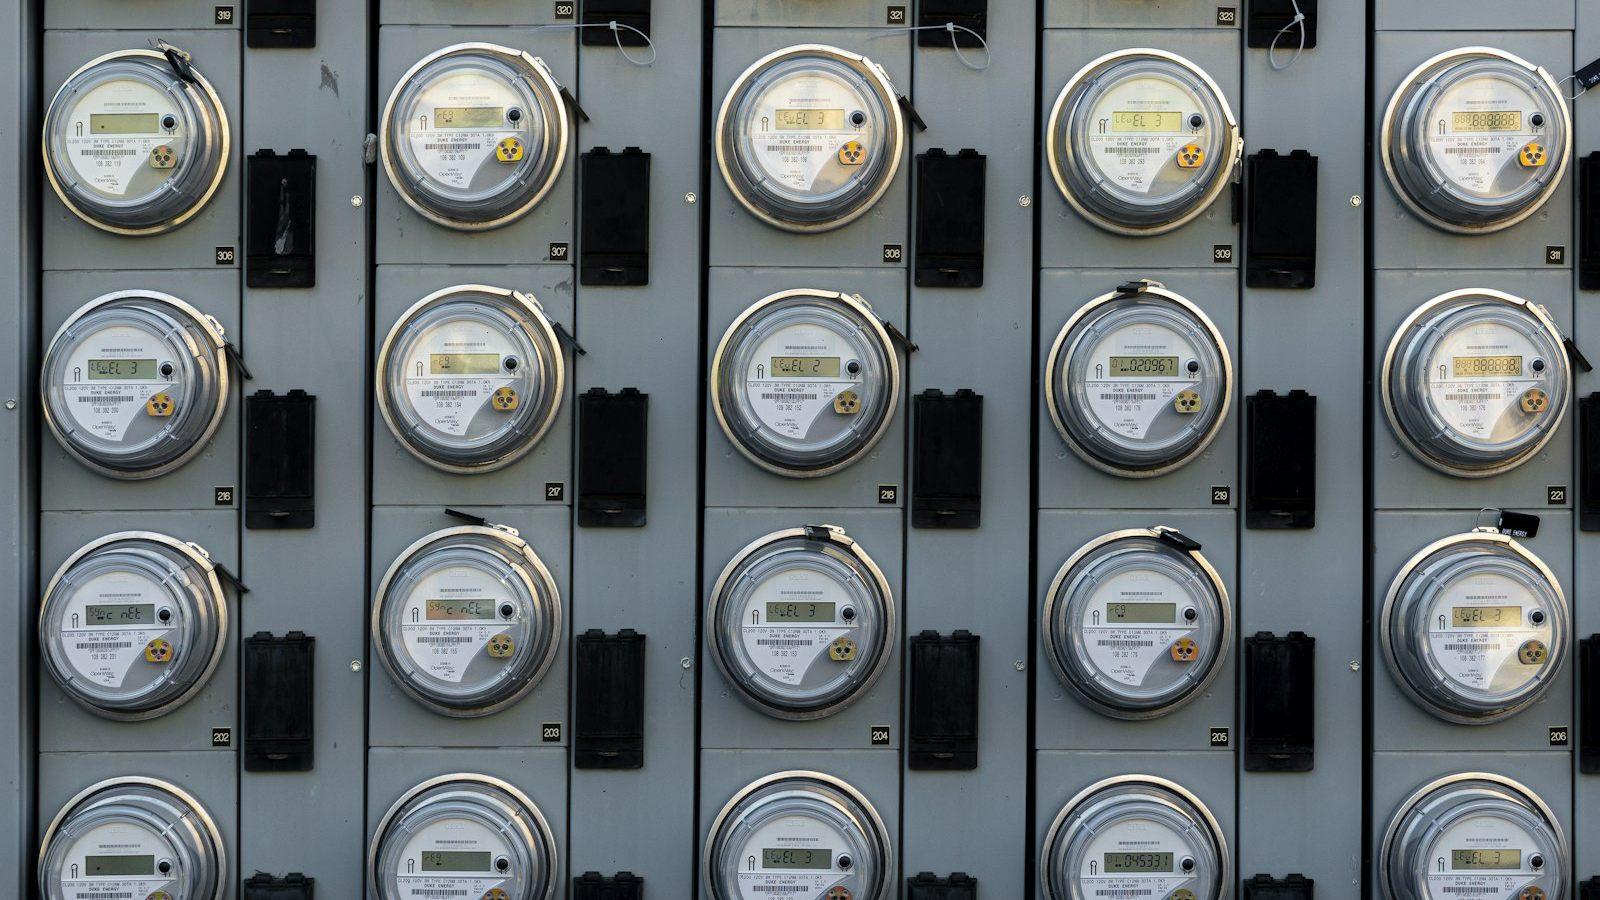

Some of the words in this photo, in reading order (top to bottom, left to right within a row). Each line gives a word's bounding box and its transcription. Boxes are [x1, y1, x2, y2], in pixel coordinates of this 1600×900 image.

[217, 10, 231, 20] 319
[556, 6, 572, 15] 320
[890, 10, 903, 20] 321
[1219, 12, 1234, 21] 323
[818, 112, 824, 124] 3
[1155, 114, 1161, 127] 3
[217, 251, 232, 260] 306
[551, 247, 567, 256] 307
[884, 249, 900, 258] 308
[1215, 249, 1230, 259] 309
[1550, 251, 1561, 260] 311
[131, 362, 137, 374] 3
[813, 360, 820, 372] 2
[217, 492, 230, 501] 216
[548, 487, 561, 497] 217
[881, 490, 894, 499] 218
[1214, 491, 1228, 500] 219
[1550, 491, 1564, 500] 221
[809, 604, 815, 617] 3
[1495, 609, 1501, 622] 3
[214, 733, 229, 742] 202
[544, 728, 559, 738] 203
[872, 731, 888, 740] 204
[1212, 732, 1227, 742] 205
[1551, 732, 1566, 741] 206
[805, 851, 812, 864] 3
[1494, 852, 1500, 864] 3
